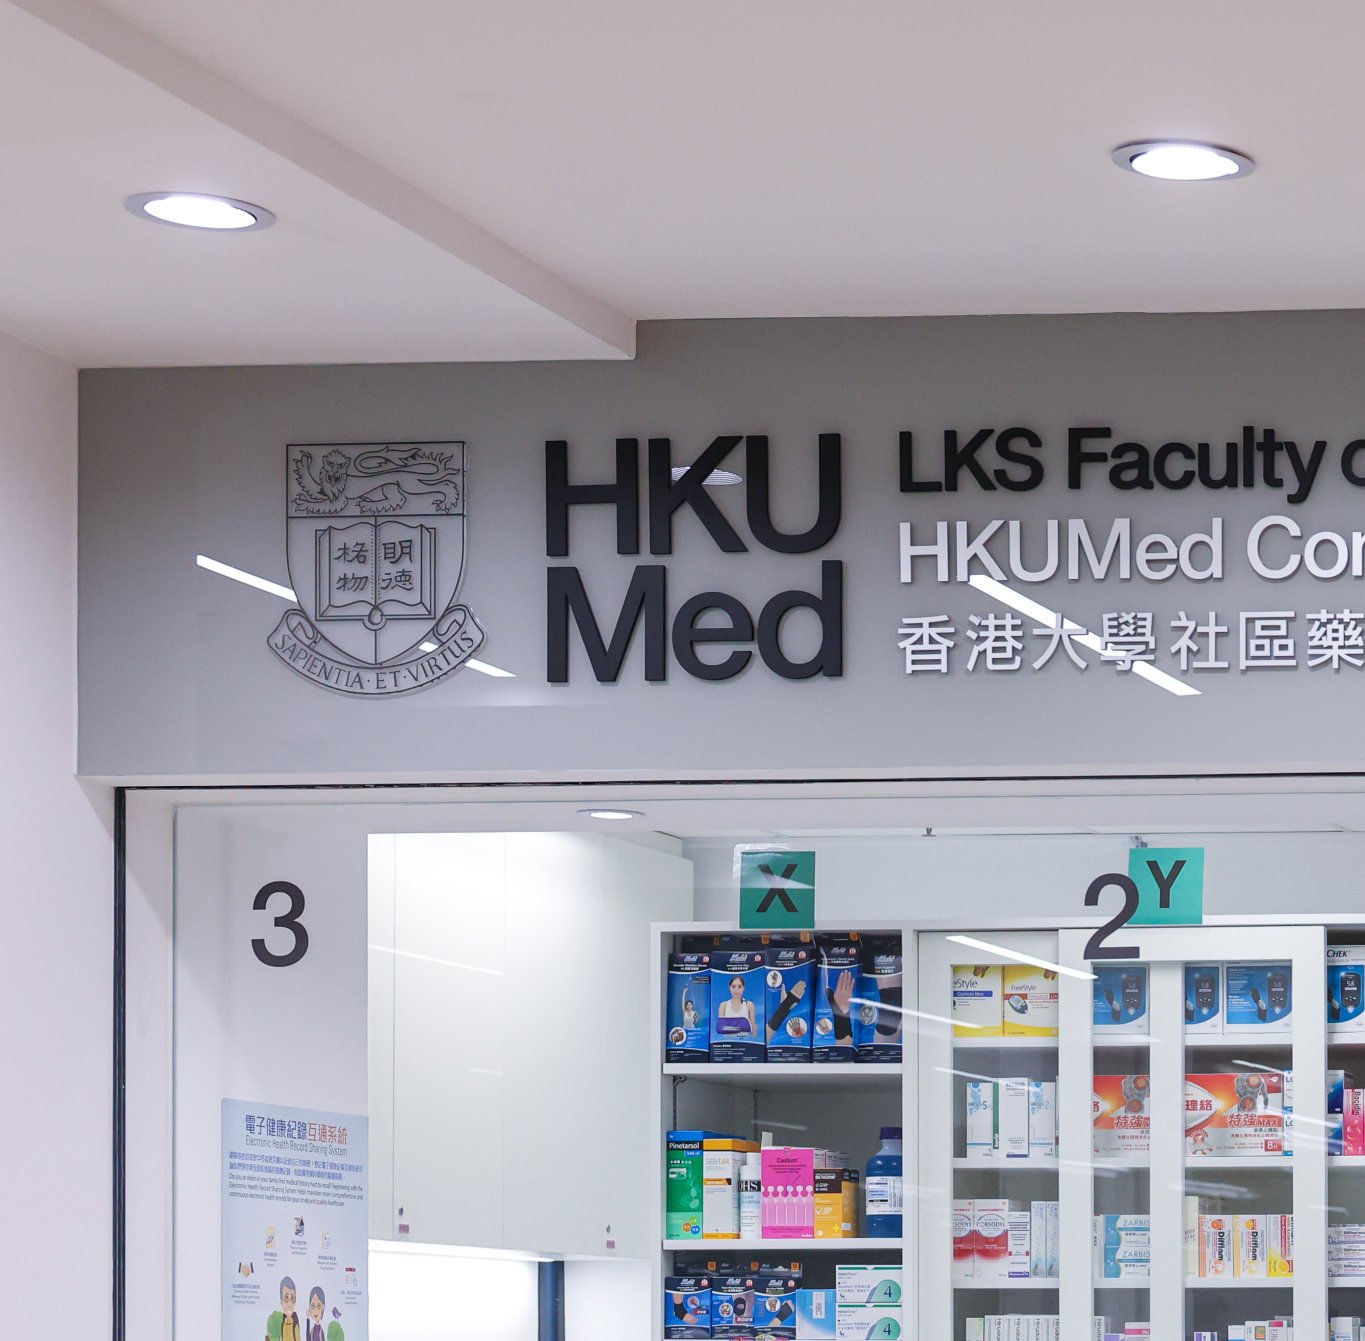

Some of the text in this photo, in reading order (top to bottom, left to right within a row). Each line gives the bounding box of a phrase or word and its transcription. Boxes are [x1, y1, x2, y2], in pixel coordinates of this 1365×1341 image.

[897, 426, 1044, 493] LKS
[1069, 425, 1326, 503] Faculty
[544, 433, 842, 557] HKU
[897, 518, 1224, 584] HKUMed
[545, 560, 844, 684] Med
[756, 863, 798, 913] X
[1146, 859, 1186, 909] Y
[251, 881, 309, 967] 3
[1083, 873, 1141, 960] 2
[1114, 1115, 1144, 1129] 特強
[1185, 1100, 1212, 1111] 理絡
[1227, 1114, 1278, 1127] 特強 MAX
[245, 1114, 348, 1145] 電子健康紀錄互通系統
[245, 1134, 348, 1157] Electronic Health Record Sharing System
[669, 1142, 700, 1150] Pinetarsol
[884, 1286, 893, 1298] 4
[883, 1323, 892, 1335] 4
